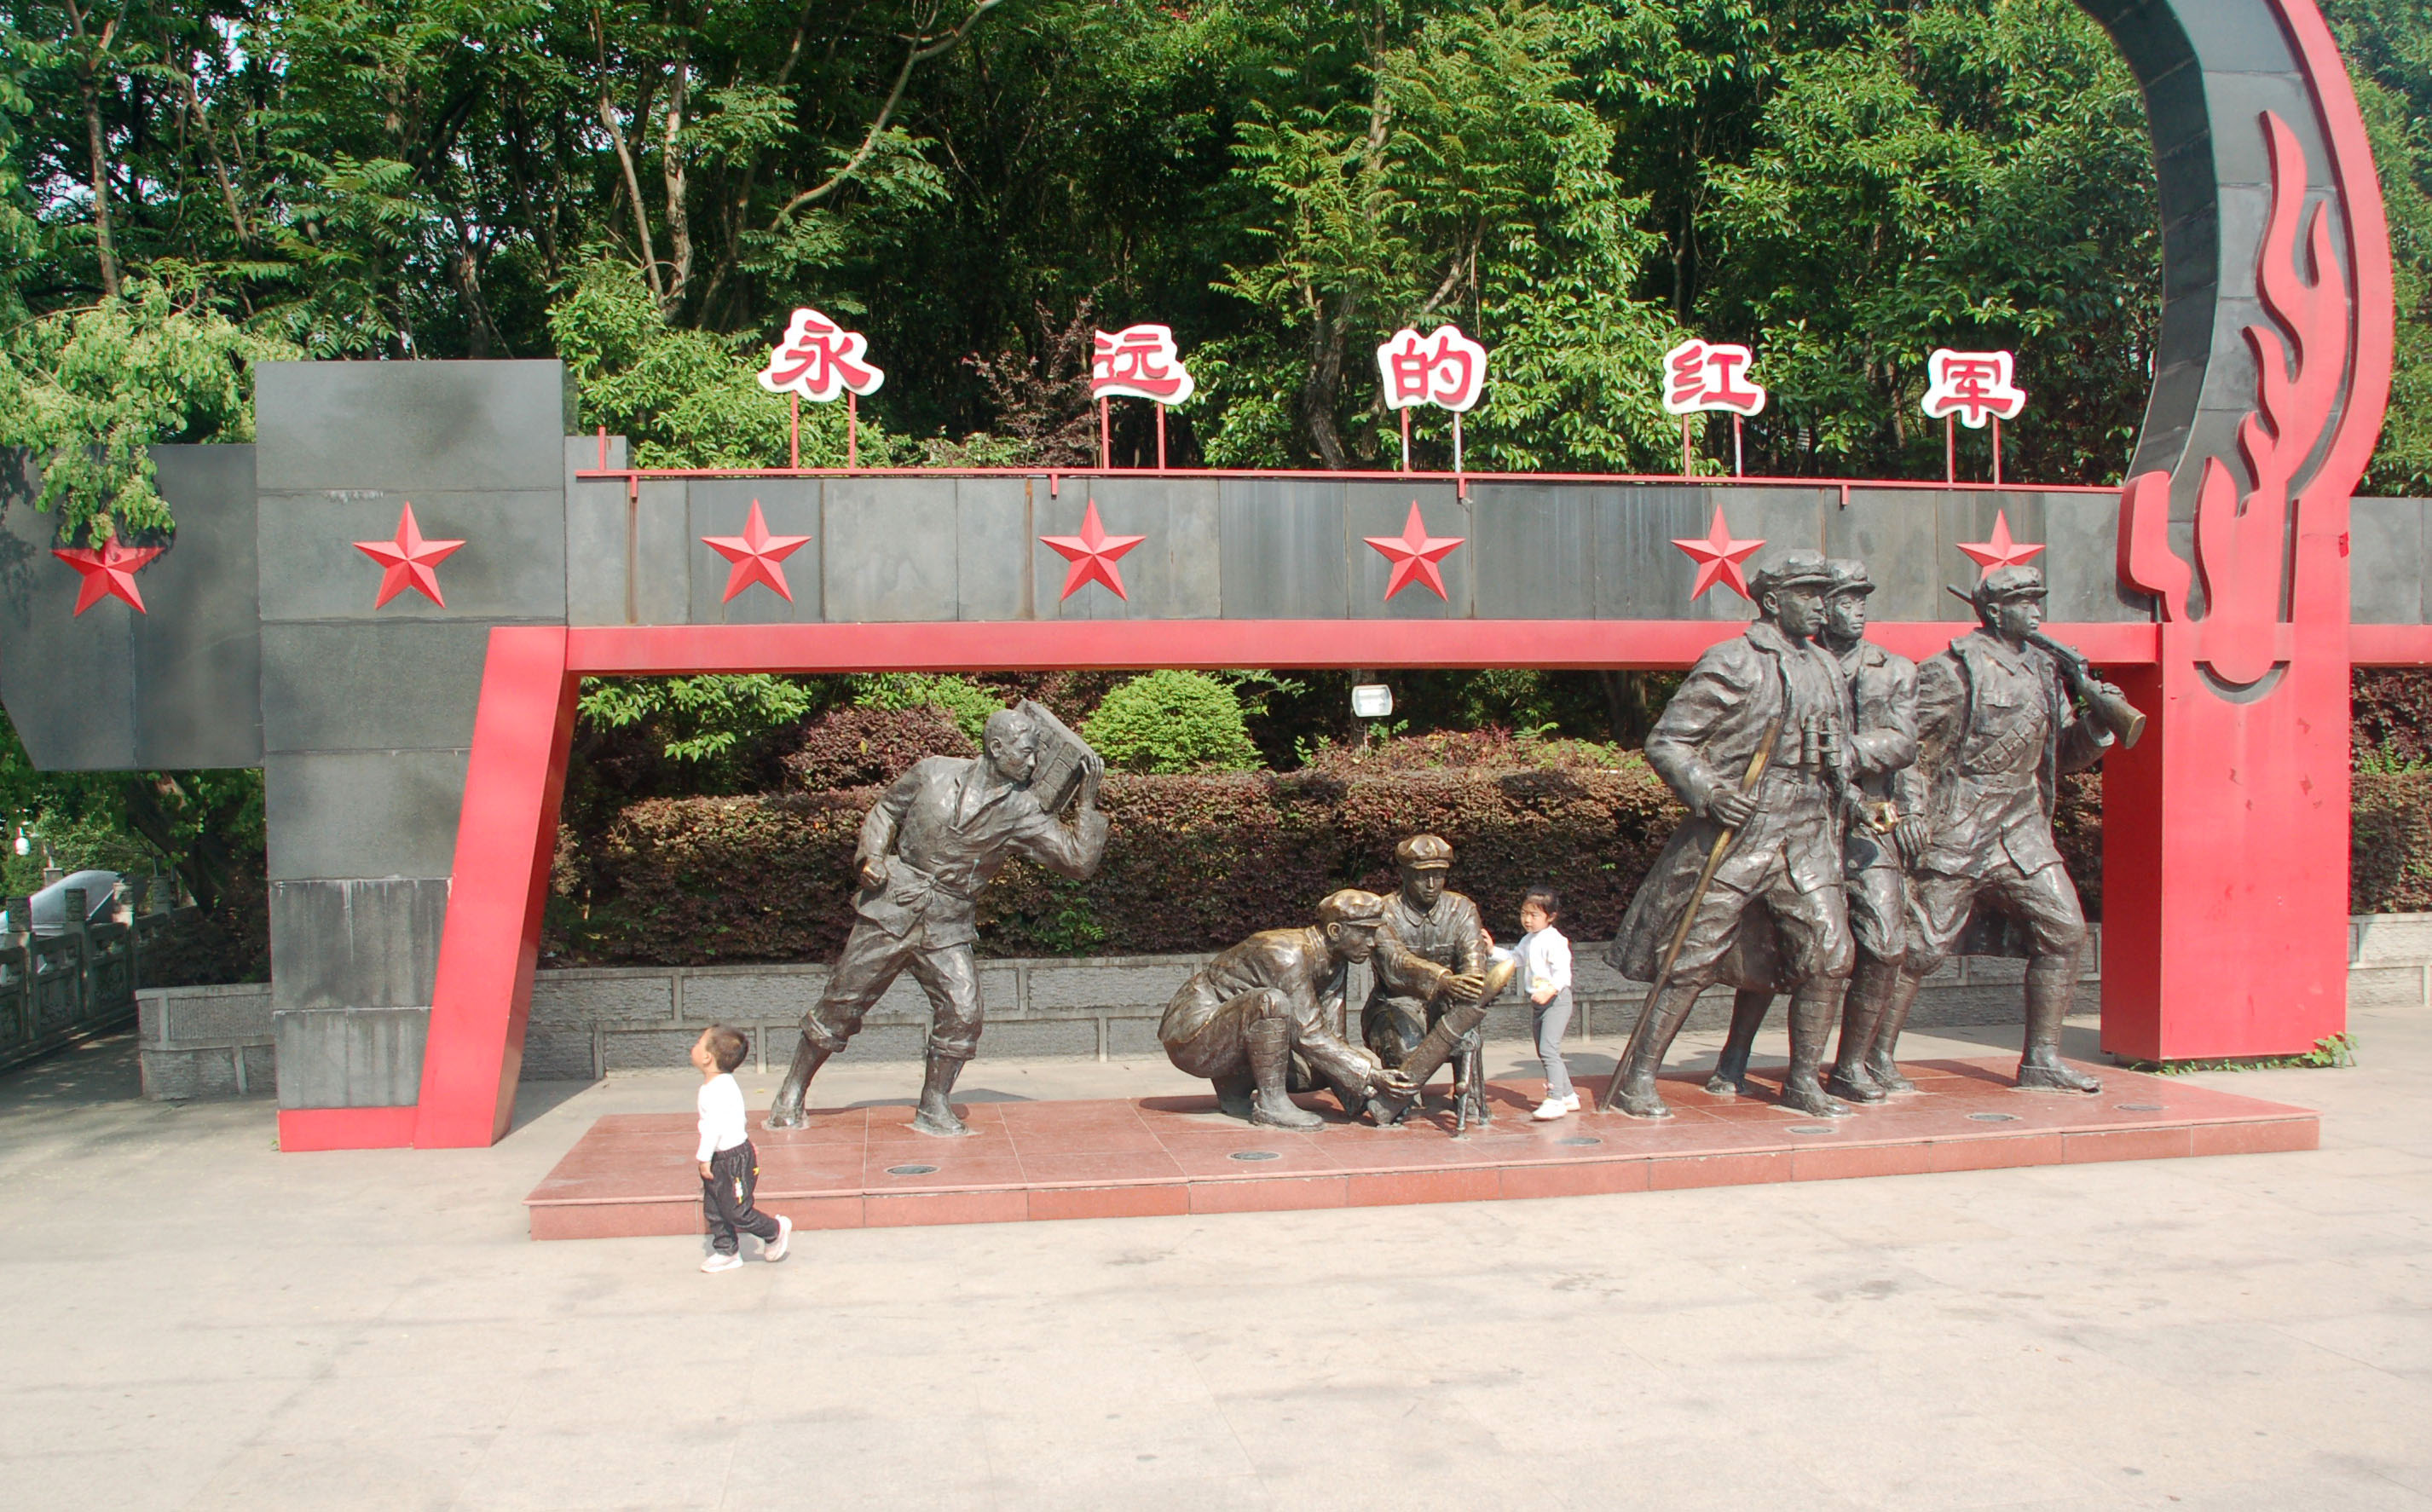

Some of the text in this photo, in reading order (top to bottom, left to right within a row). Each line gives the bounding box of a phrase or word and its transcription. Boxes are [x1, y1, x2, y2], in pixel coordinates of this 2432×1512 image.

[771, 320, 2013, 421] 永远的红军
